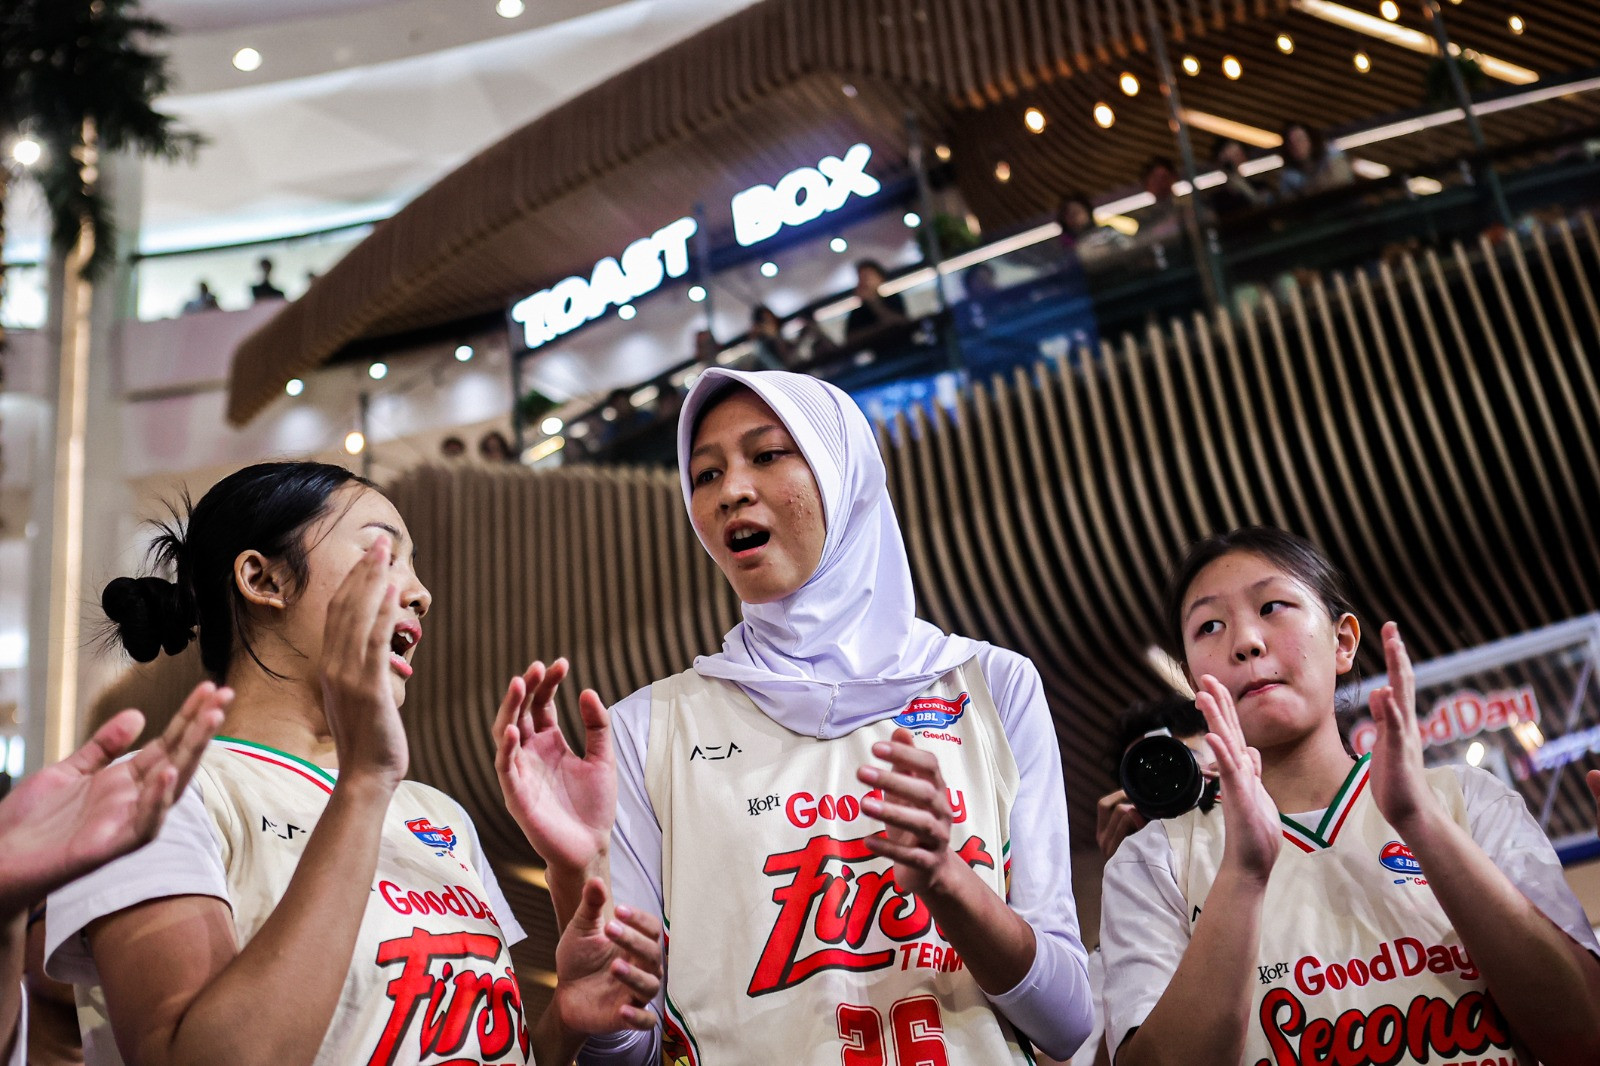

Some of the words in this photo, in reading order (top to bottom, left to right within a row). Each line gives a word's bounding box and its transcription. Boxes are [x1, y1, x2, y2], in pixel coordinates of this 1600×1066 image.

[512, 216, 698, 349] TOAST
[731, 143, 881, 247] BOX
[913, 702, 956, 713] HONDA
[916, 712, 938, 722] DBL
[899, 942, 963, 973] TEAM
